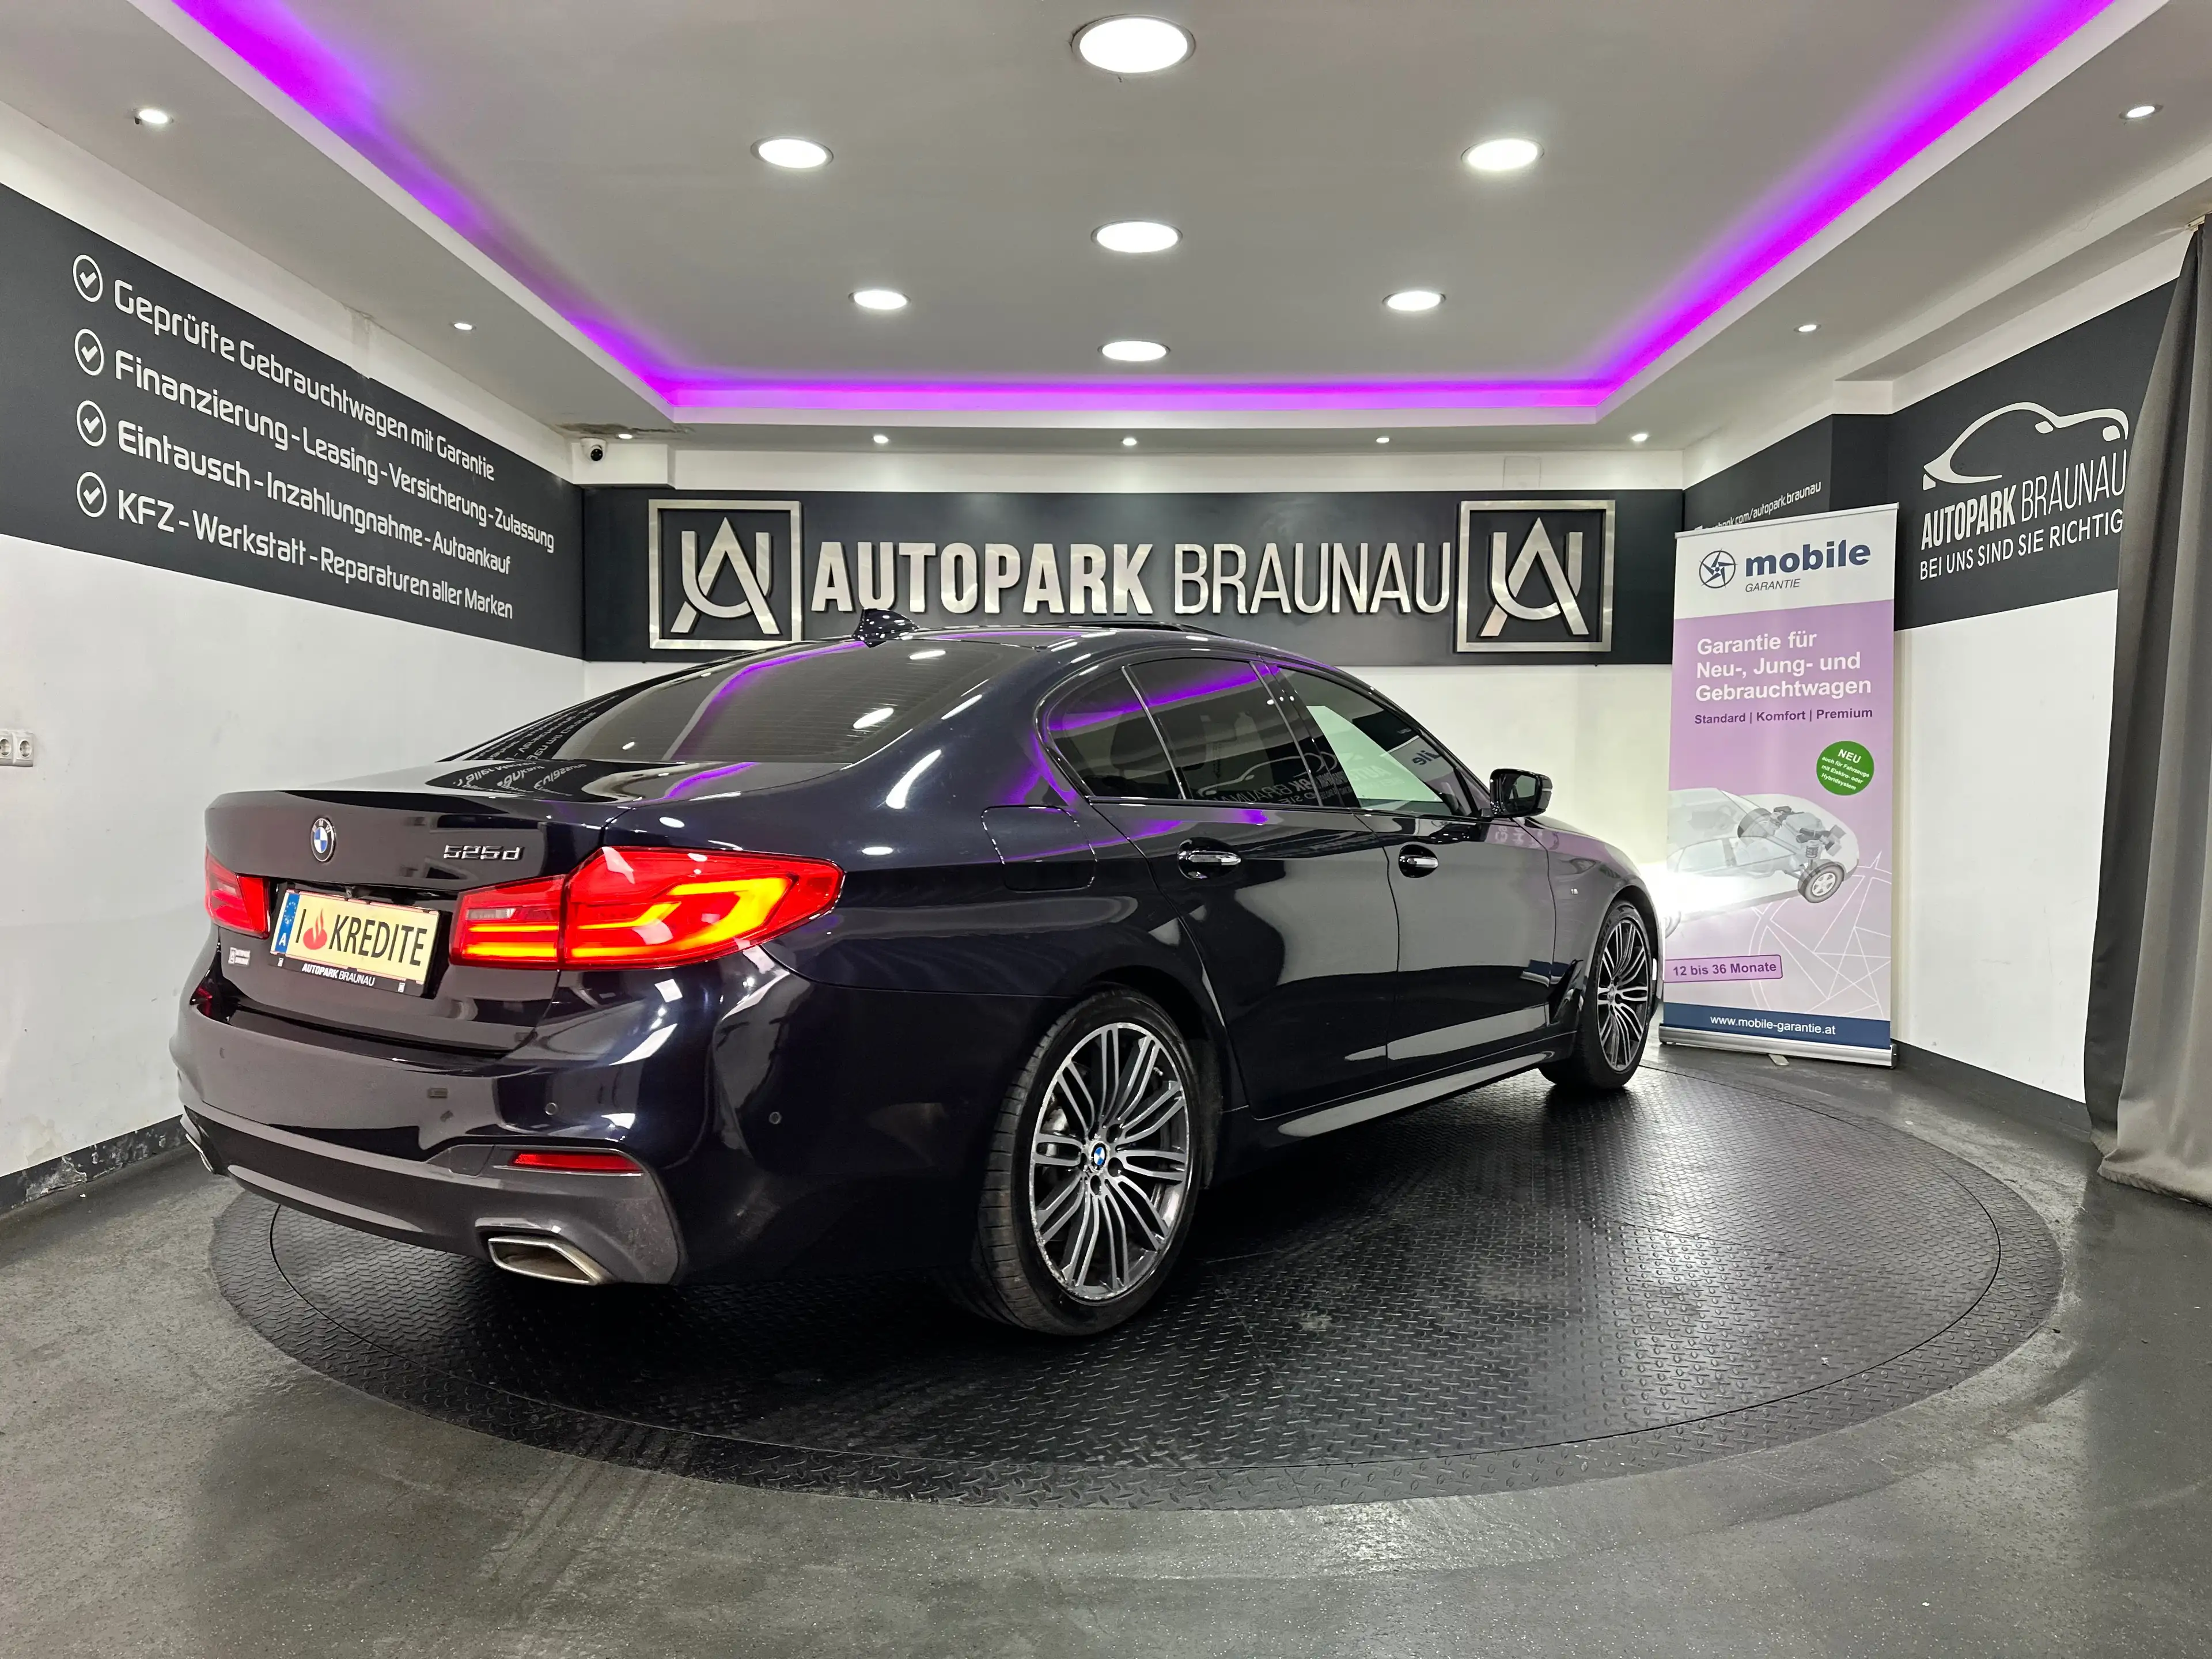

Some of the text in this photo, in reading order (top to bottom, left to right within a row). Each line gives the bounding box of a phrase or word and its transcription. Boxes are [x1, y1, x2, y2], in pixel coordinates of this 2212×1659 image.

[115, 280, 494, 480] Geprüfte Gebrauchtwagen mit Garantie
[119, 421, 250, 491] Eintausch
[433, 531, 510, 574] Autoankauf
[1921, 449, 2127, 550] AUTOPARK BRAUNAU
[495, 507, 554, 553] Zulassung
[119, 490, 174, 532] KFZ
[192, 510, 306, 565] Werkstatt
[321, 547, 429, 597] Reparaturen
[433, 581, 462, 605] aller
[465, 588, 512, 619] Marken
[1920, 509, 2123, 581] BEI UNS SIND SIE RICHTIG
[1746, 540, 1871, 577] mobile
[812, 542, 1450, 614] AUTOPARK BRAUNAU
[1745, 578, 1801, 593] GARANTIE
[1697, 630, 1817, 655] Garantie für
[1696, 652, 1860, 679] Neu-, Jung- und
[1696, 680, 1872, 702] Gebrauchtwagen
[1694, 713, 1746, 724] Standard
[1756, 710, 1806, 721] Komfort
[1816, 709, 1873, 719] Premium
[1821, 756, 1835, 764] auch
[1843, 764, 1869, 778] Fahrzeuge
[1838, 749, 1861, 763] NEU
[1821, 773, 1857, 790] Hybridsystem
[1851, 776, 1863, 784] oder
[444, 844, 522, 861] 525d
[279, 932, 287, 946] A
[296, 908, 427, 967] I KREDITE
[301, 963, 376, 987] AUTOPARK BRAUNAU
[1673, 962, 1777, 976] 12 bis 36 Monate
[1710, 1016, 1836, 1035] www.mobile-garantie.at
